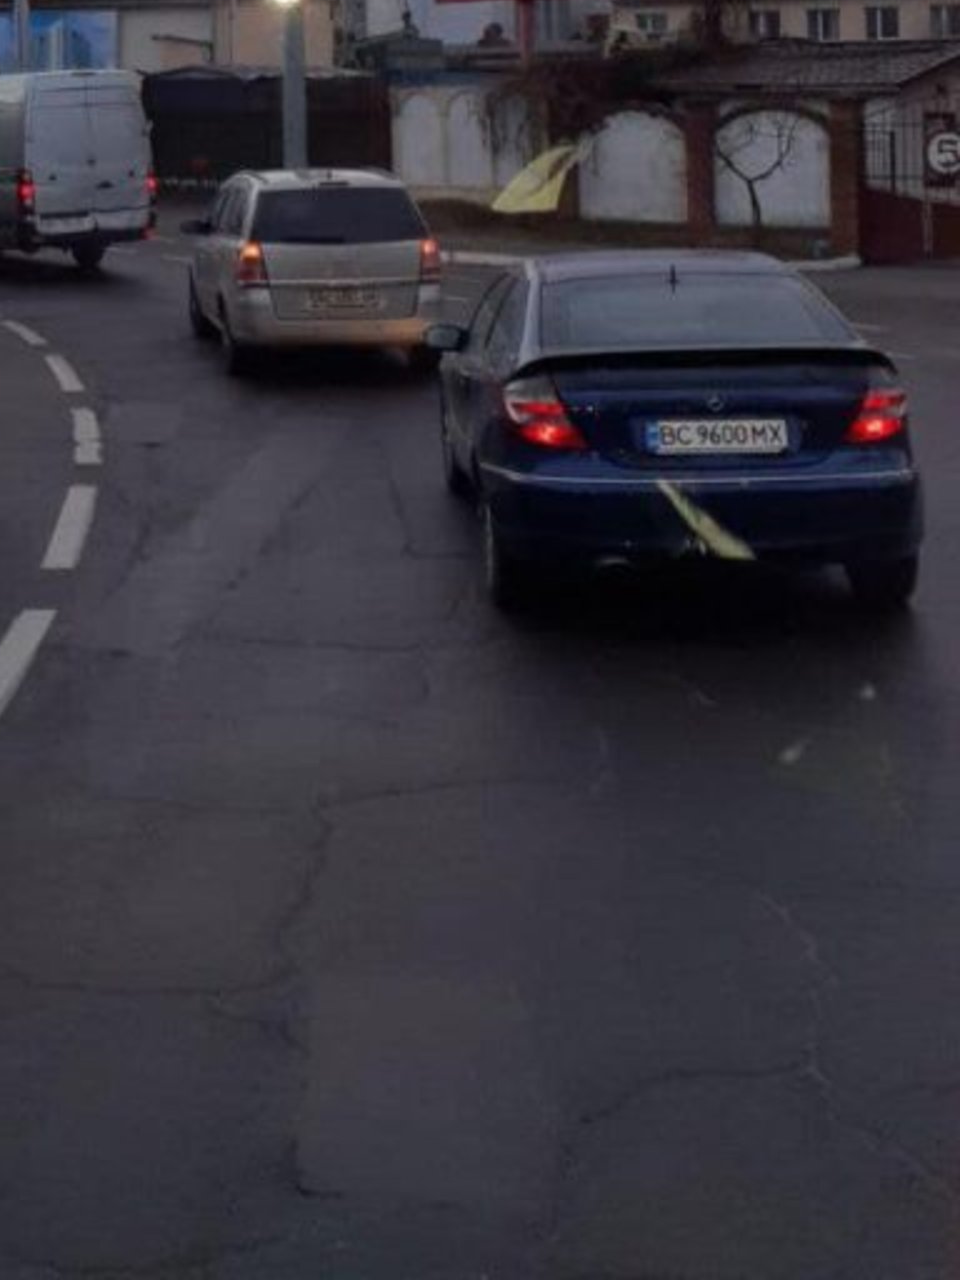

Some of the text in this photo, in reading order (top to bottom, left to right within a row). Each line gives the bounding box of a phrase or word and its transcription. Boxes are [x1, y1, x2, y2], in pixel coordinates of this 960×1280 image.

[659, 424, 783, 446] BC 9600 MX
